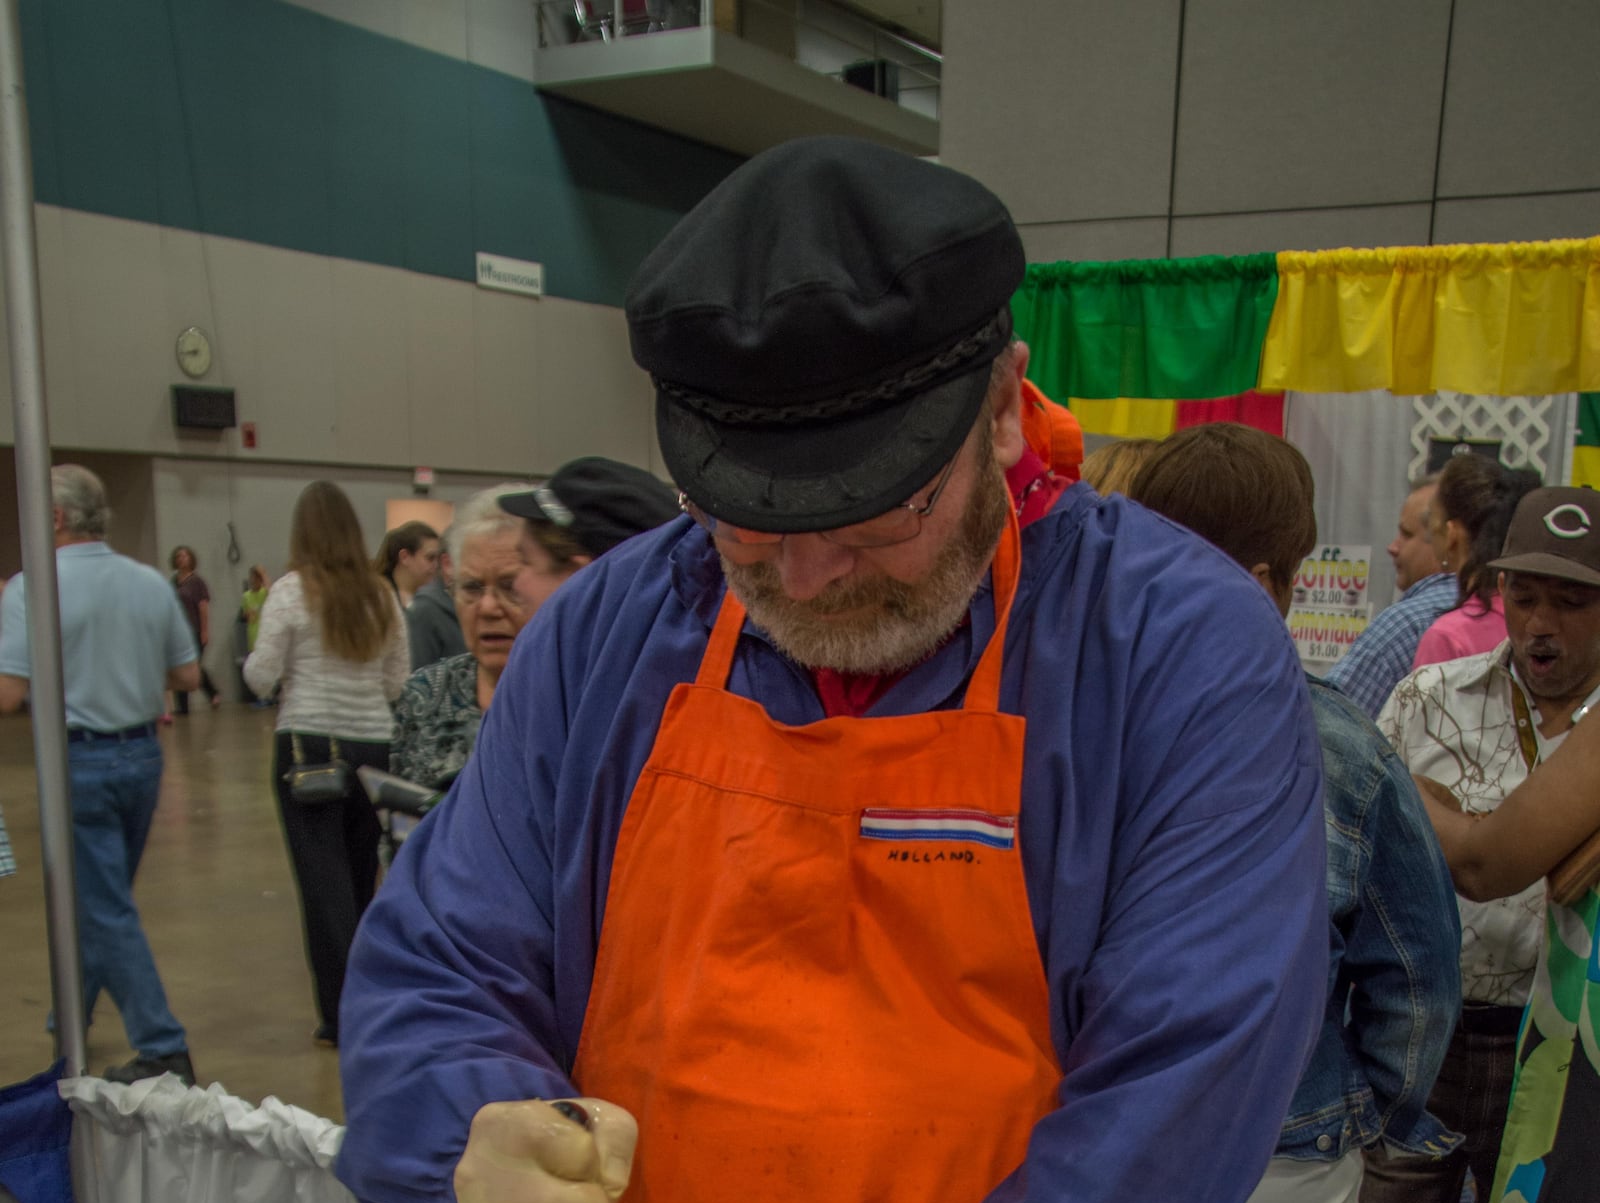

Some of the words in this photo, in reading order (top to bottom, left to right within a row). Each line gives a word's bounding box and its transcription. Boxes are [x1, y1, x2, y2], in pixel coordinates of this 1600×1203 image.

[491, 270, 540, 289] RESTROOMS
[1543, 503, 1591, 539] C
[1311, 590, 1342, 604] $2.00
[1308, 643, 1339, 658] $1.00
